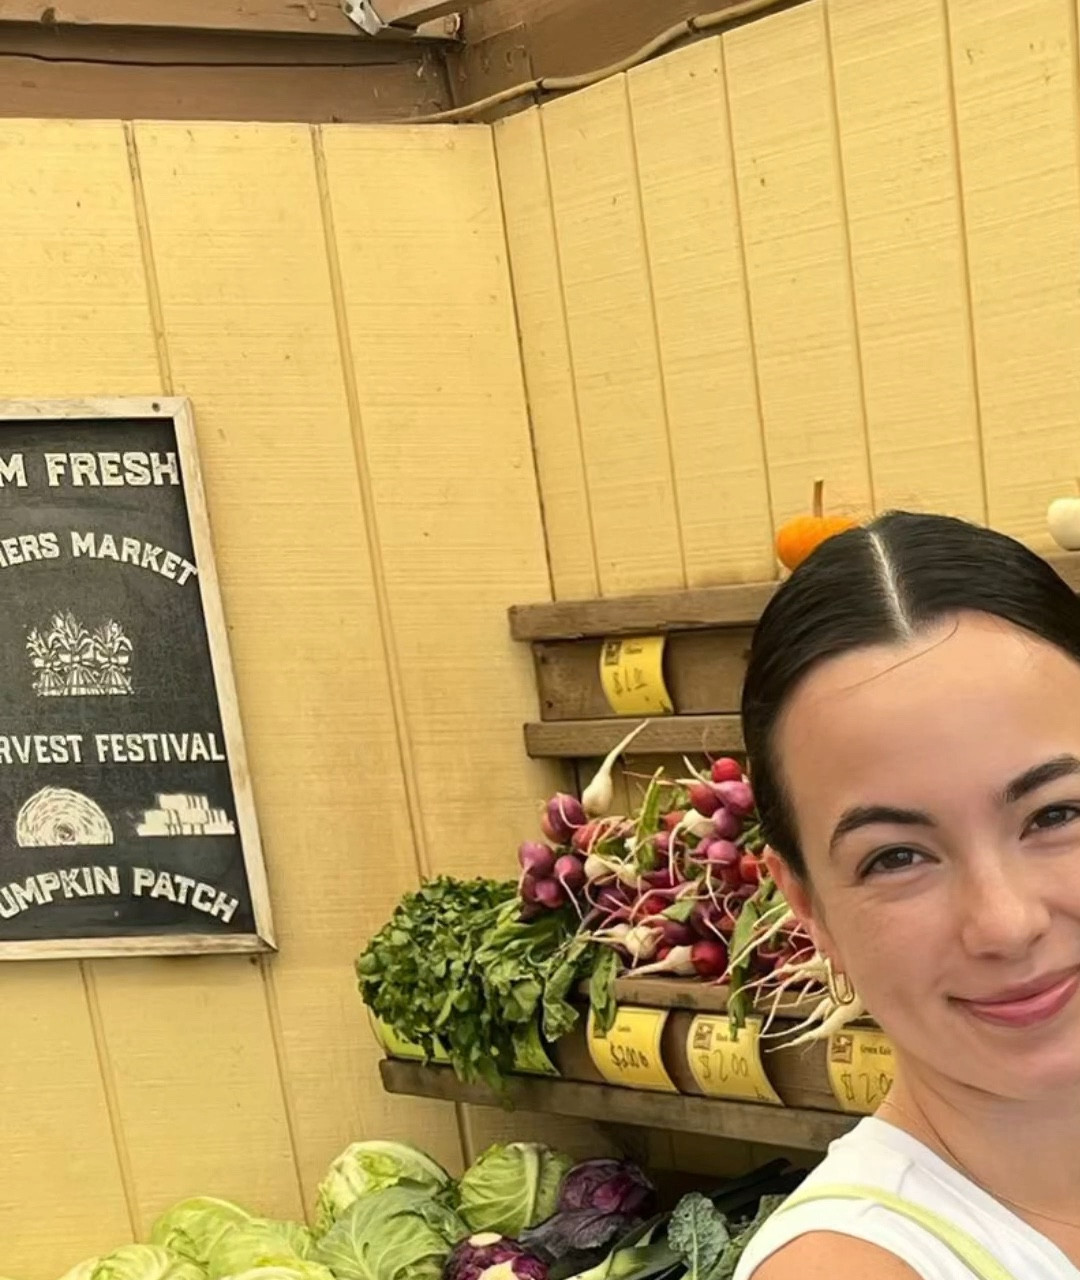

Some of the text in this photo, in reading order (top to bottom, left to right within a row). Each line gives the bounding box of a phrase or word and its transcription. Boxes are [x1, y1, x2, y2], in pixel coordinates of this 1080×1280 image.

[44, 451, 181, 487] FRESH
[70, 530, 200, 587] MARKET
[94, 732, 226, 763] FESTIVAL
[0, 866, 240, 923] UMPKIN PATCH
